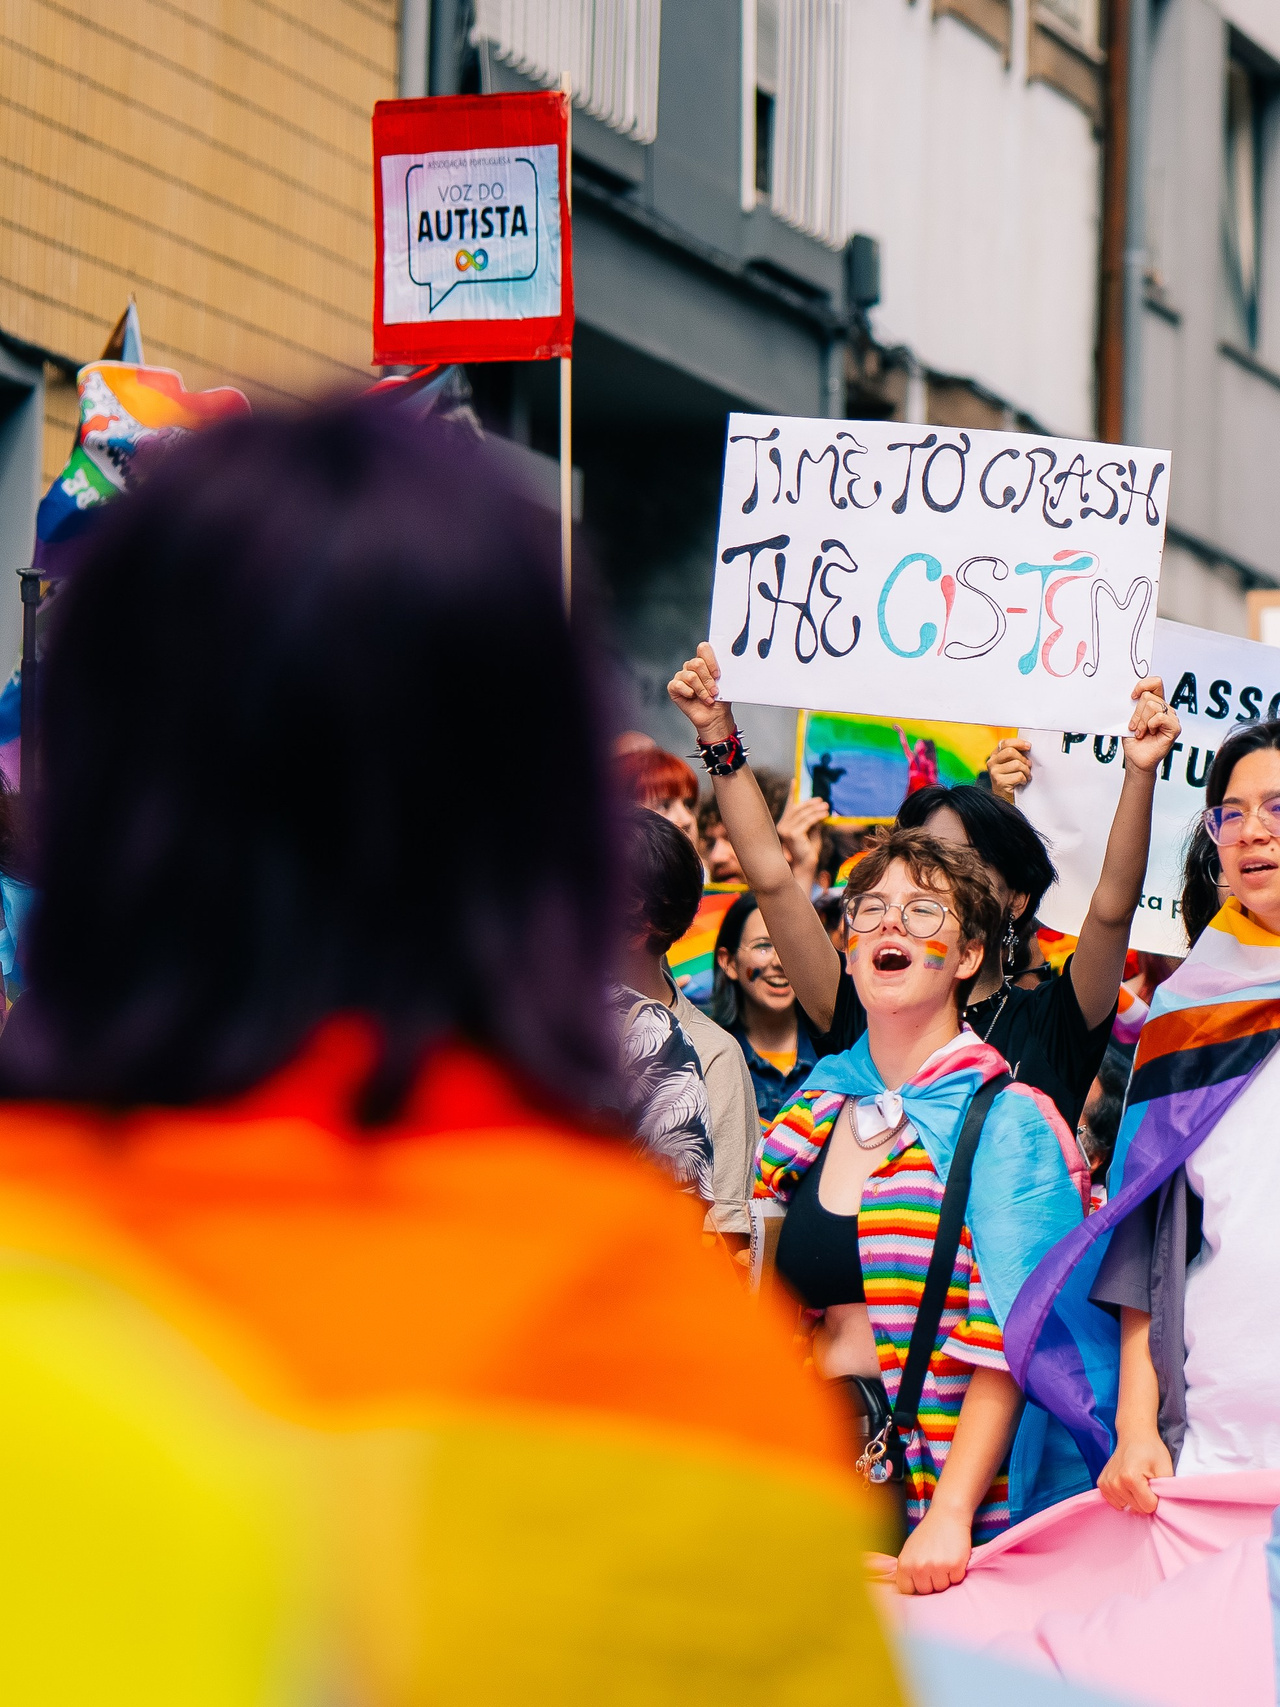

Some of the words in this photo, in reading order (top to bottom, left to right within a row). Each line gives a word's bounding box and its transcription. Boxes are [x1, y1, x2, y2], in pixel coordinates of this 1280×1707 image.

[418, 206, 528, 242] AUTISTA
[438, 184, 472, 202] VOZ
[478, 182, 504, 200] DO
[730, 428, 881, 514] TIME
[887, 433, 971, 514] TO
[980, 447, 1165, 528] CRASH
[721, 534, 861, 663] THE
[877, 549, 1153, 679] CIS-TEM
